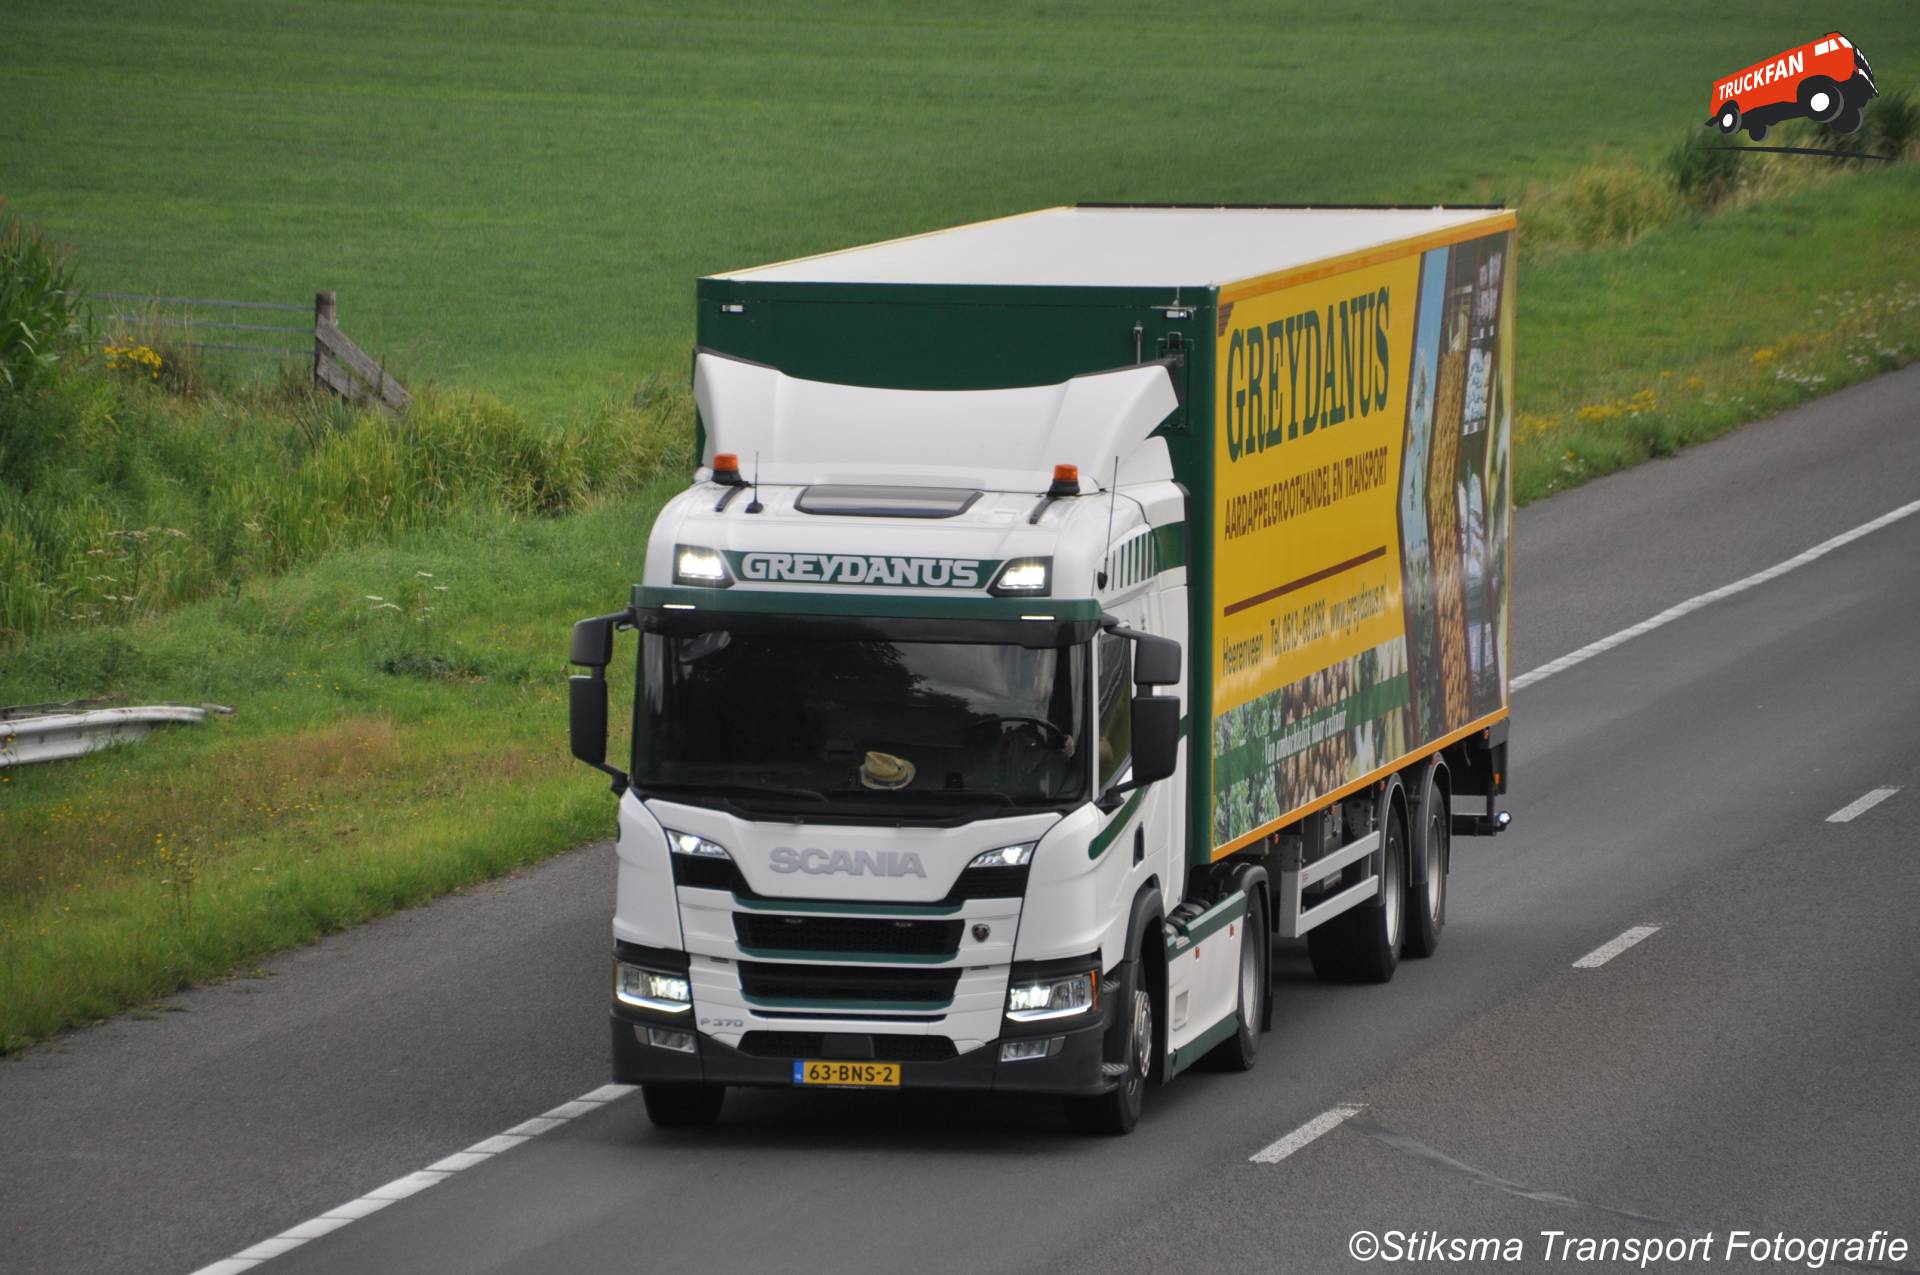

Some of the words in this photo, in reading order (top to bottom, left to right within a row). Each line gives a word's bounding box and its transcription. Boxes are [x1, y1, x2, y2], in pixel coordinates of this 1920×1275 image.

[1226, 286, 1390, 463] GREYDANUS
[1225, 465, 1331, 542] AARDAPPELGROOTHANDEL
[1333, 456, 1344, 502] EN
[1345, 446, 1388, 497] TRANSPORT
[741, 552, 980, 588] GREYDANUS
[768, 846, 928, 879] SCANIA
[700, 1018, 710, 1026] P
[713, 1019, 744, 1028] 370
[809, 1064, 894, 1083] 63-BNS-2
